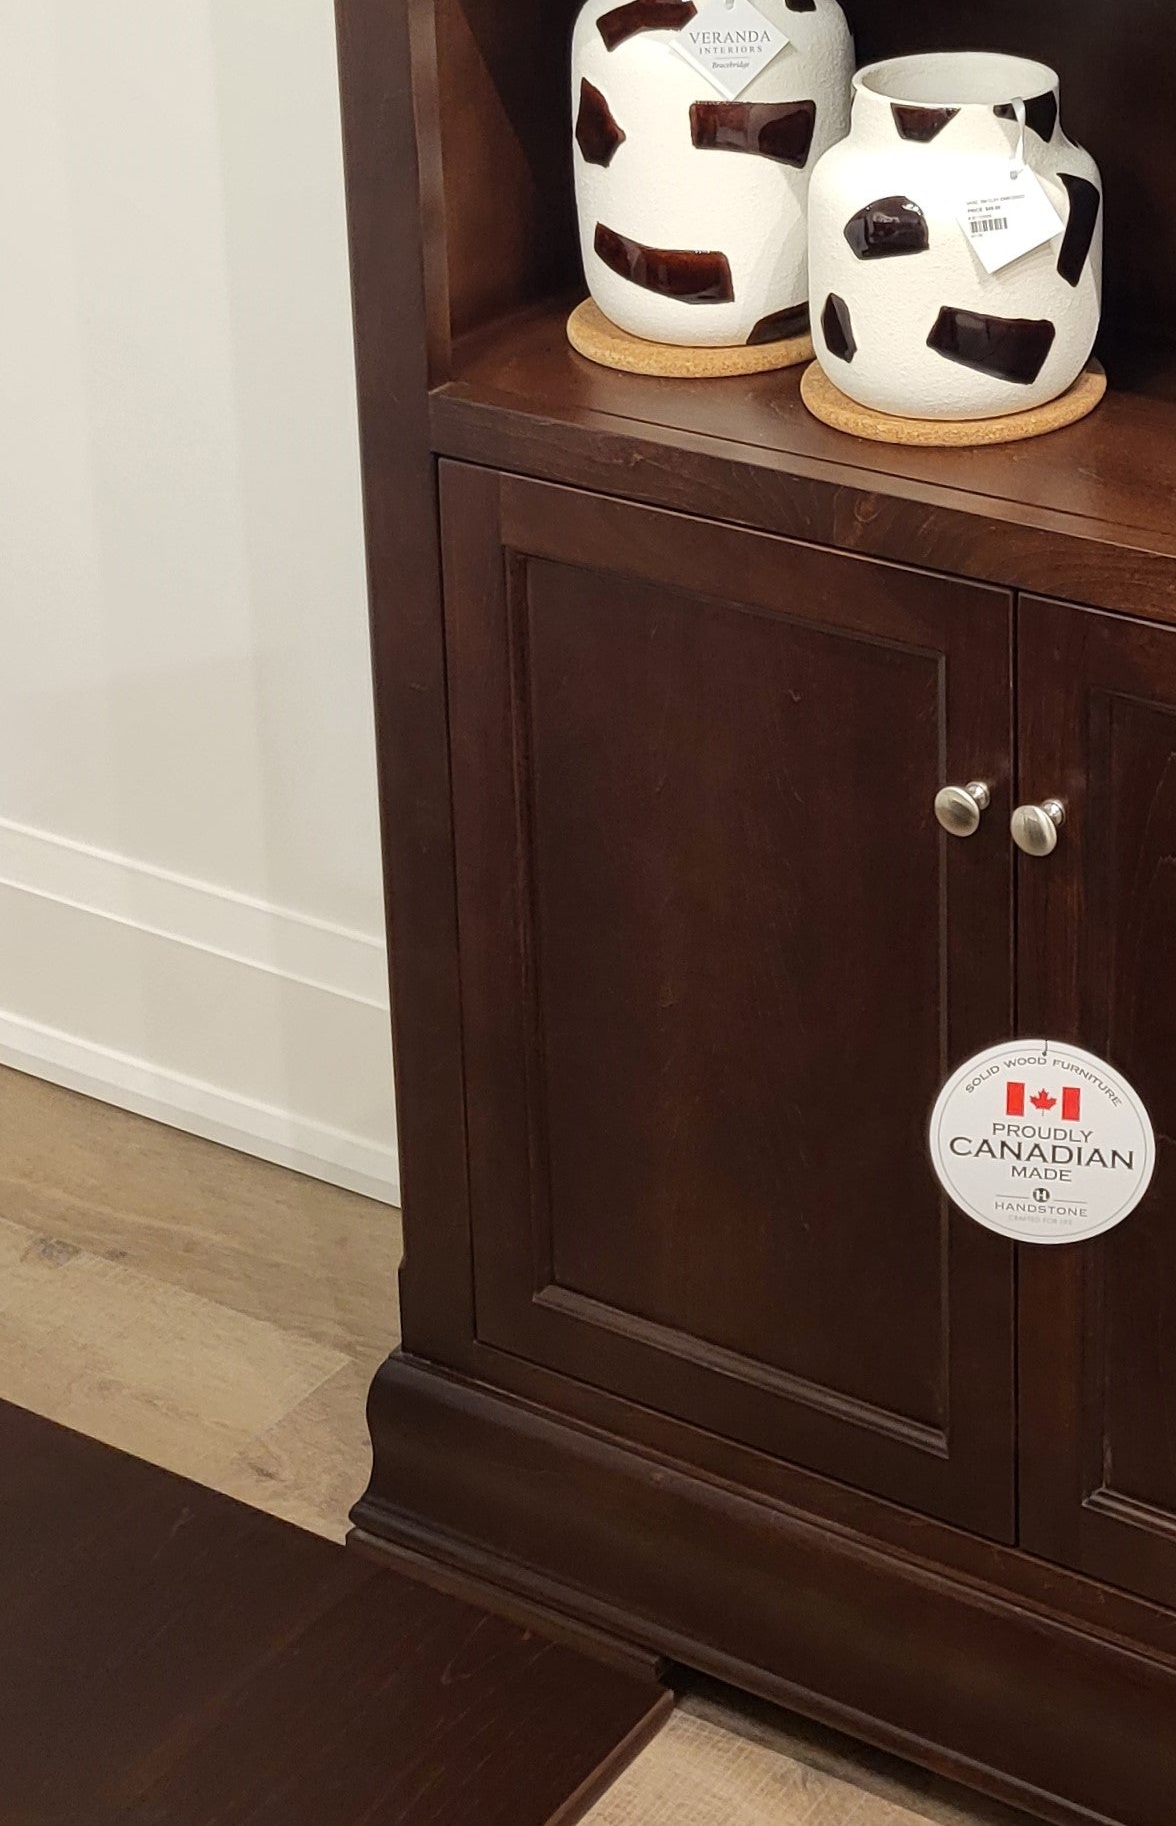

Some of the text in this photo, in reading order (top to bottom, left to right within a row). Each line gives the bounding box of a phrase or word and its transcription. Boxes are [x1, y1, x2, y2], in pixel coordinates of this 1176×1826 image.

[689, 30, 771, 44] VERANDA
[700, 46, 762, 54] INTERIORS
[965, 1057, 1122, 1107] SOLID WOOD FURNITURE
[992, 1123, 1093, 1143] PROUDLY
[949, 1137, 1134, 1170] CANADIAN
[1011, 1166, 1072, 1182] MADE
[995, 1201, 1088, 1217] HANDSTONE
